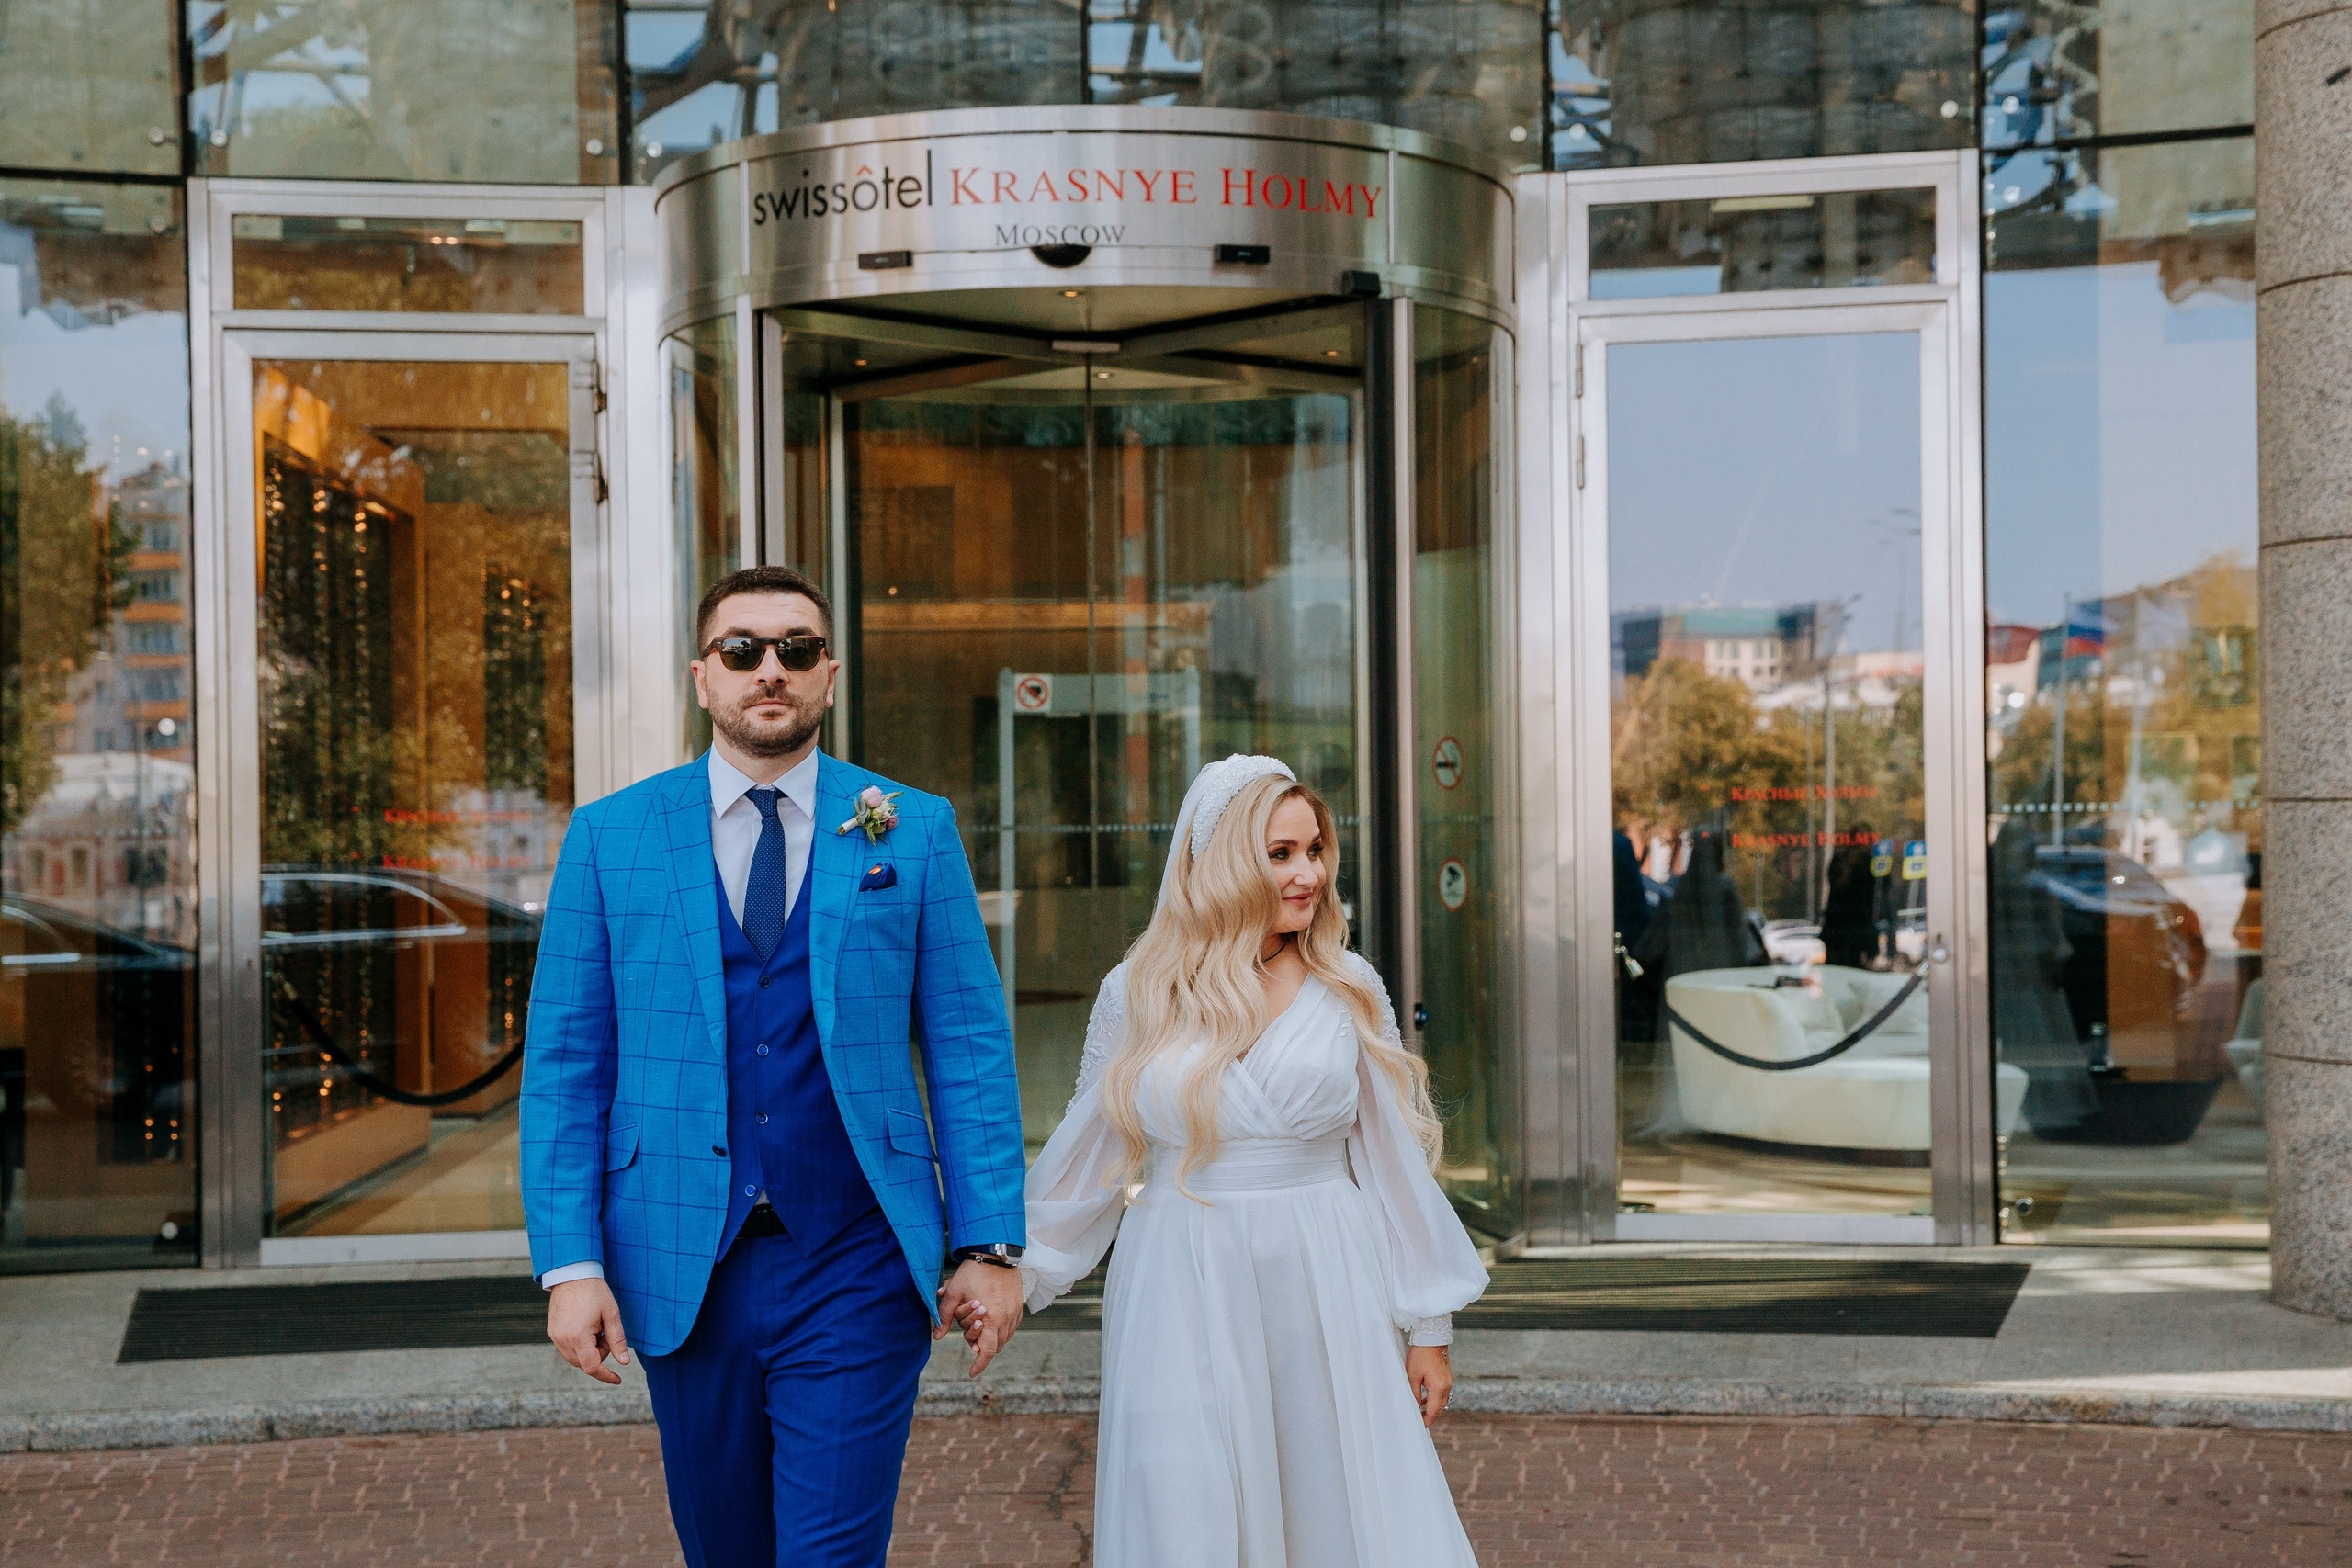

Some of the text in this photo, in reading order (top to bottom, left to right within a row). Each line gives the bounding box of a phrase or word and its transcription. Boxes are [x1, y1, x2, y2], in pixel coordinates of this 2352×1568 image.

[753, 149, 1382, 226] swissôtel KRASNYE HOLMY
[995, 223, 1126, 246] MOSCOW
